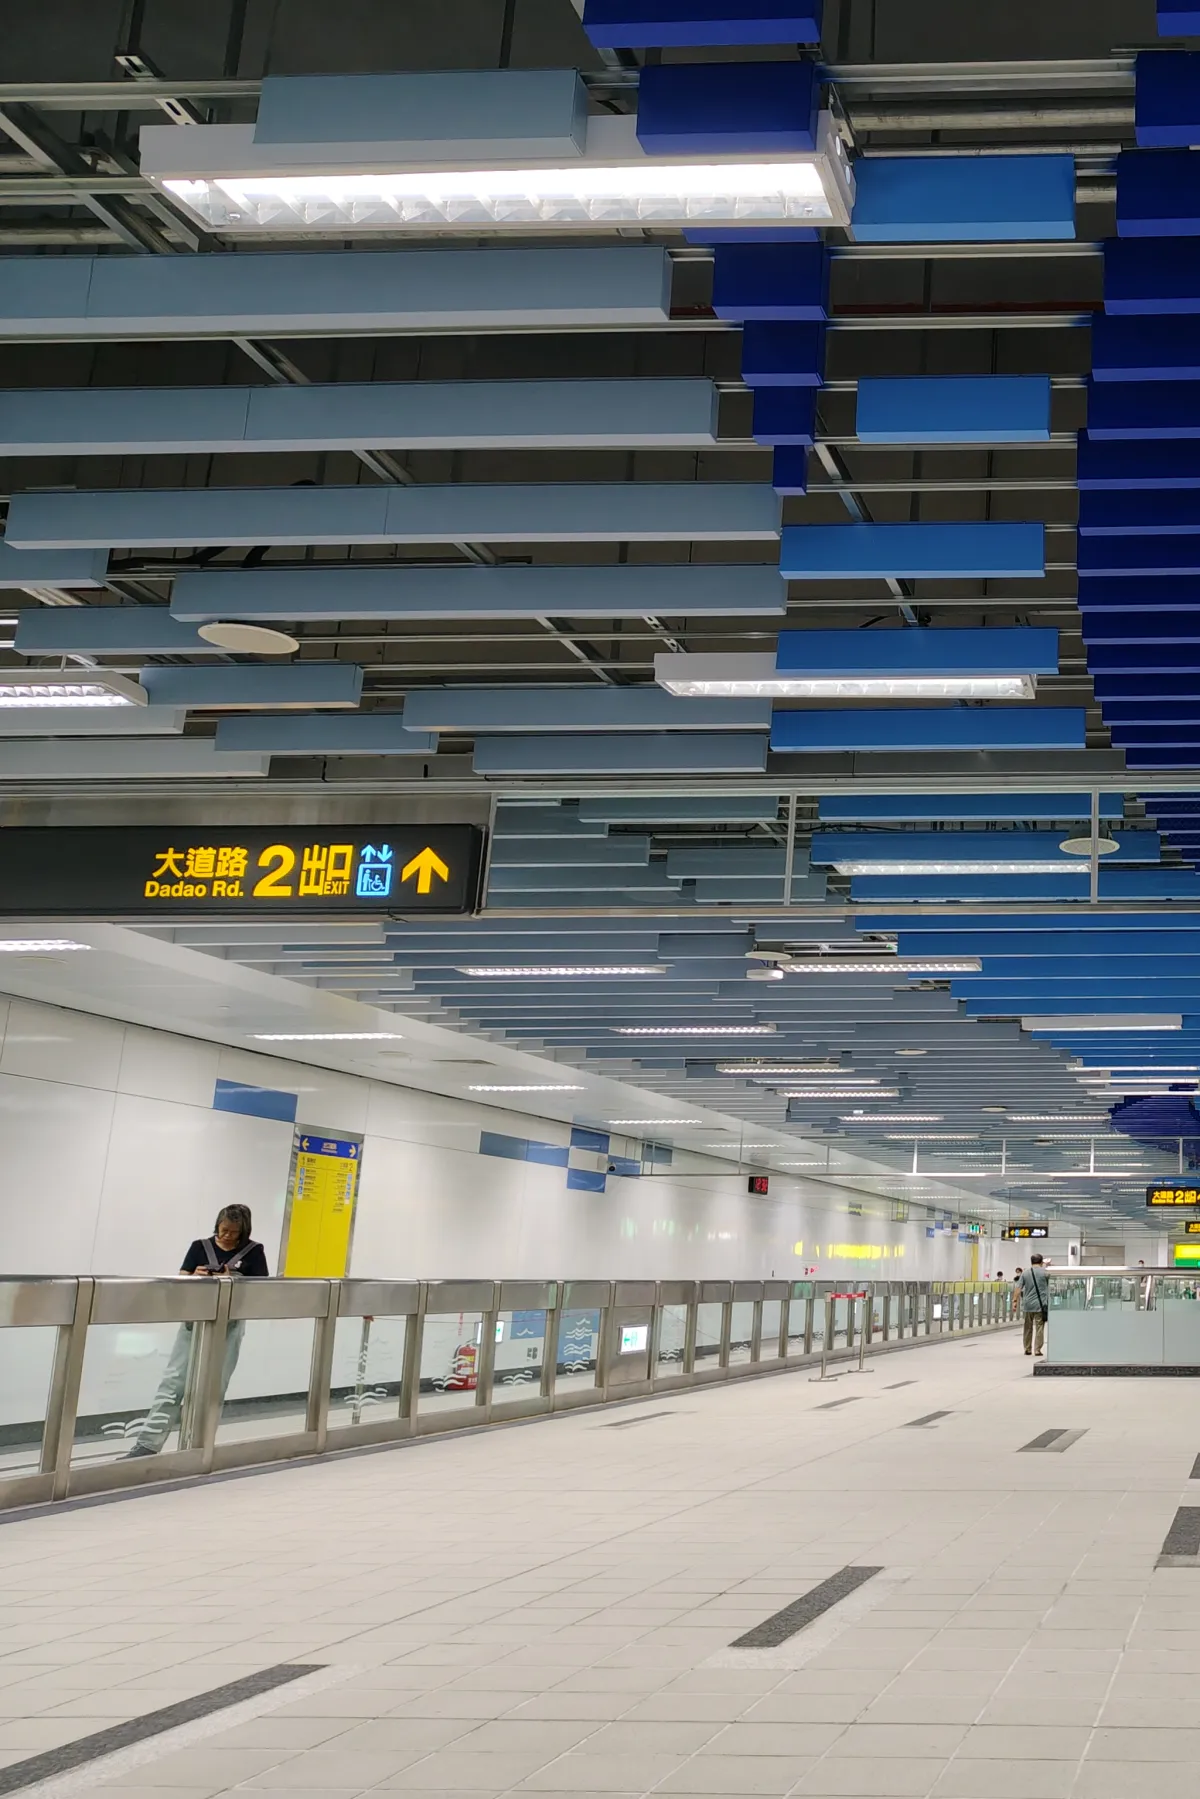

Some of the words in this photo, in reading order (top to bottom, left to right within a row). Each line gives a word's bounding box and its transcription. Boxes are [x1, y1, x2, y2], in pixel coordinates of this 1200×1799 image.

[152, 847, 248, 878] 大道路
[253, 844, 295, 896] 2
[299, 845, 353, 896] 出口
[144, 880, 207, 897] Dadao
[211, 880, 244, 897] Rd.
[324, 881, 350, 895] EXIT
[1175, 1190, 1184, 1203] 2
